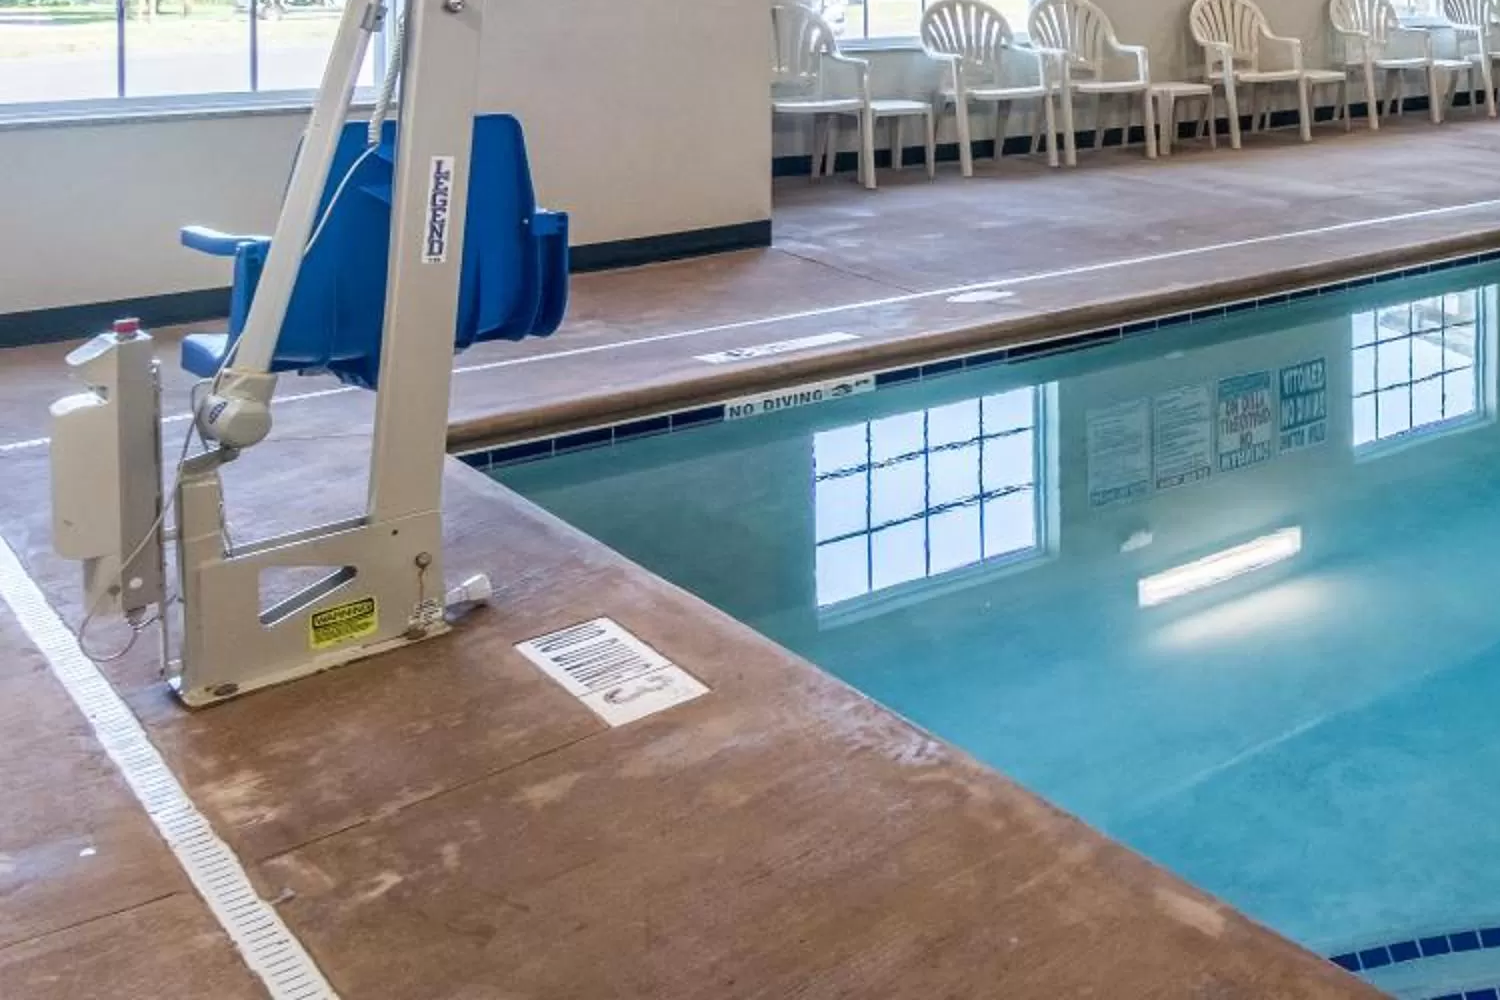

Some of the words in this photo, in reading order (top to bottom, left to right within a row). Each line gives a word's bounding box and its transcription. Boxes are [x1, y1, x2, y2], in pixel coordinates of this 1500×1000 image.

[427, 160, 450, 256] LEGEND
[729, 403, 754, 418] NO
[763, 389, 822, 411] DIVING
